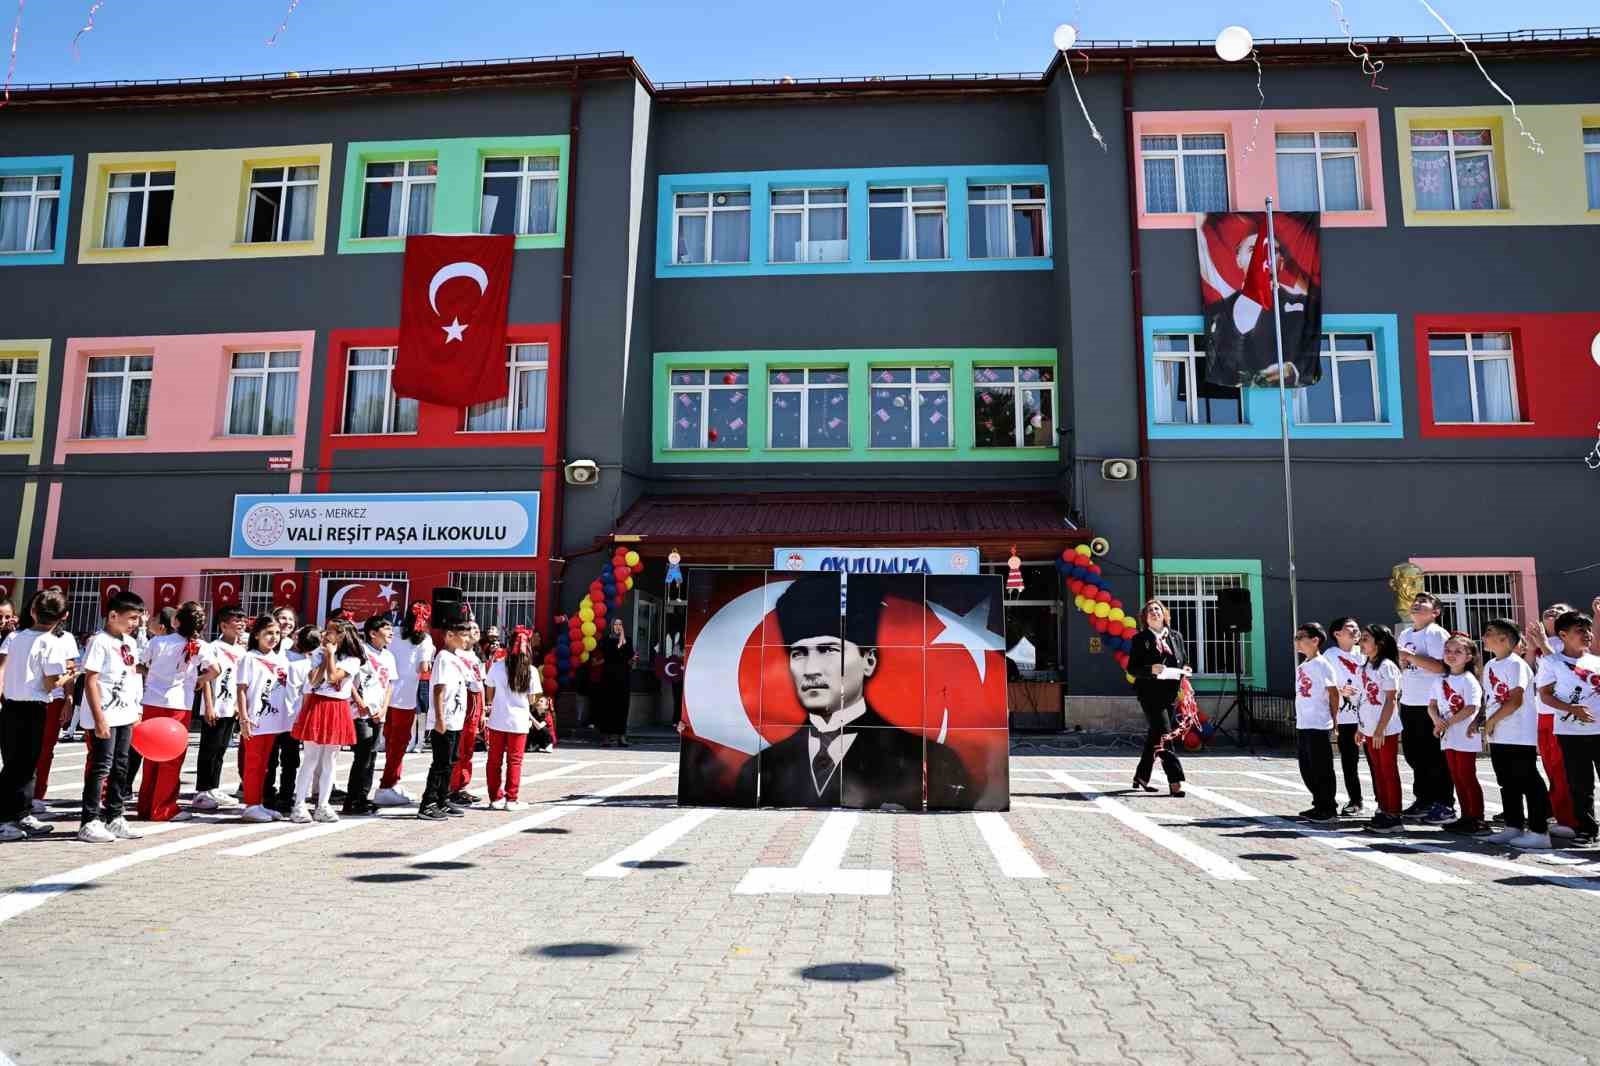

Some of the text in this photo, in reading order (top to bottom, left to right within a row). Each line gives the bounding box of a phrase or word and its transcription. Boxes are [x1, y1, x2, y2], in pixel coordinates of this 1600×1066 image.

[288, 508, 317, 519] SİVAS
[325, 508, 368, 519] MERKEZ
[287, 523, 507, 544] VALİ REŞİT PAŞA İLKOKULU
